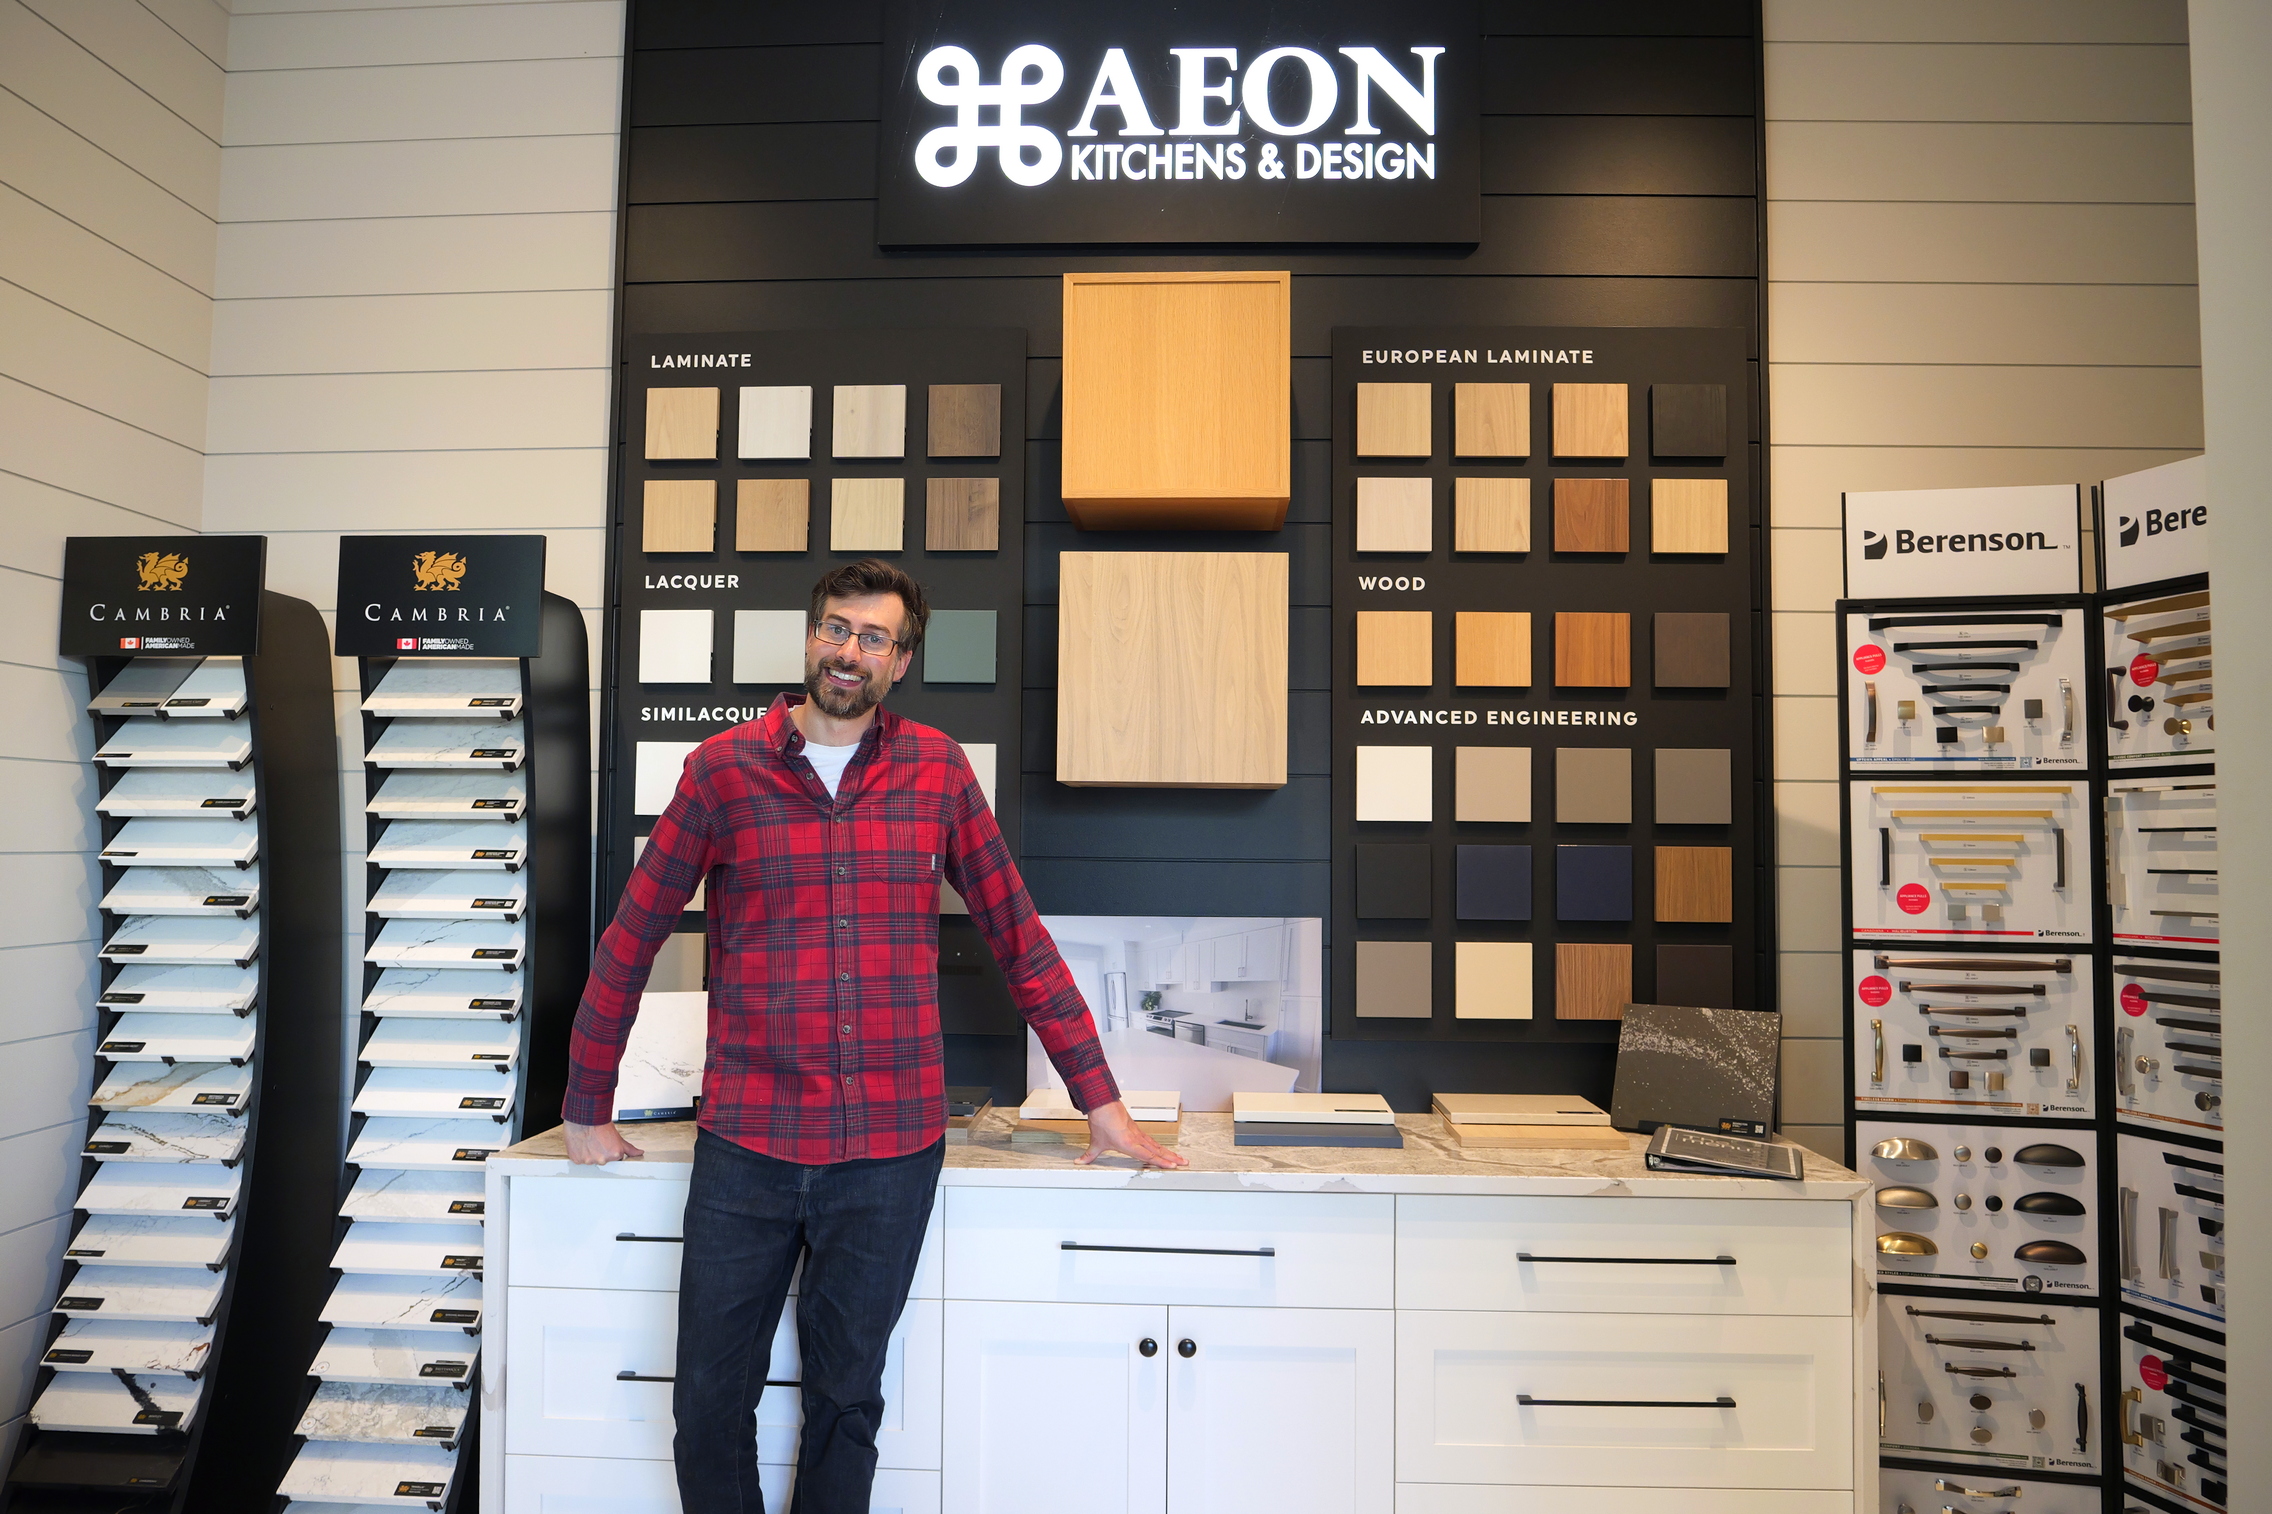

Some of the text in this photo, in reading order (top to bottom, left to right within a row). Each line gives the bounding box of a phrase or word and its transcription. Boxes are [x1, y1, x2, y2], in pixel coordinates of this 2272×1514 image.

[1067, 46, 1445, 136] AEON
[1071, 142, 1435, 181] KITCHENS & DESIGN
[651, 354, 752, 368] LAMINATE
[1362, 350, 1594, 364] EUROPEAN LAMINATE
[1896, 529, 2058, 554] Berenson
[645, 575, 739, 590] LACQUER
[1358, 576, 1426, 591] WOOD
[1360, 710, 1638, 726] ADVANCED ENGINEERING
[2050, 1104, 2088, 1113] Berenson
[2054, 1281, 2092, 1290] Berenson
[2056, 1459, 2094, 1468] Berenson
